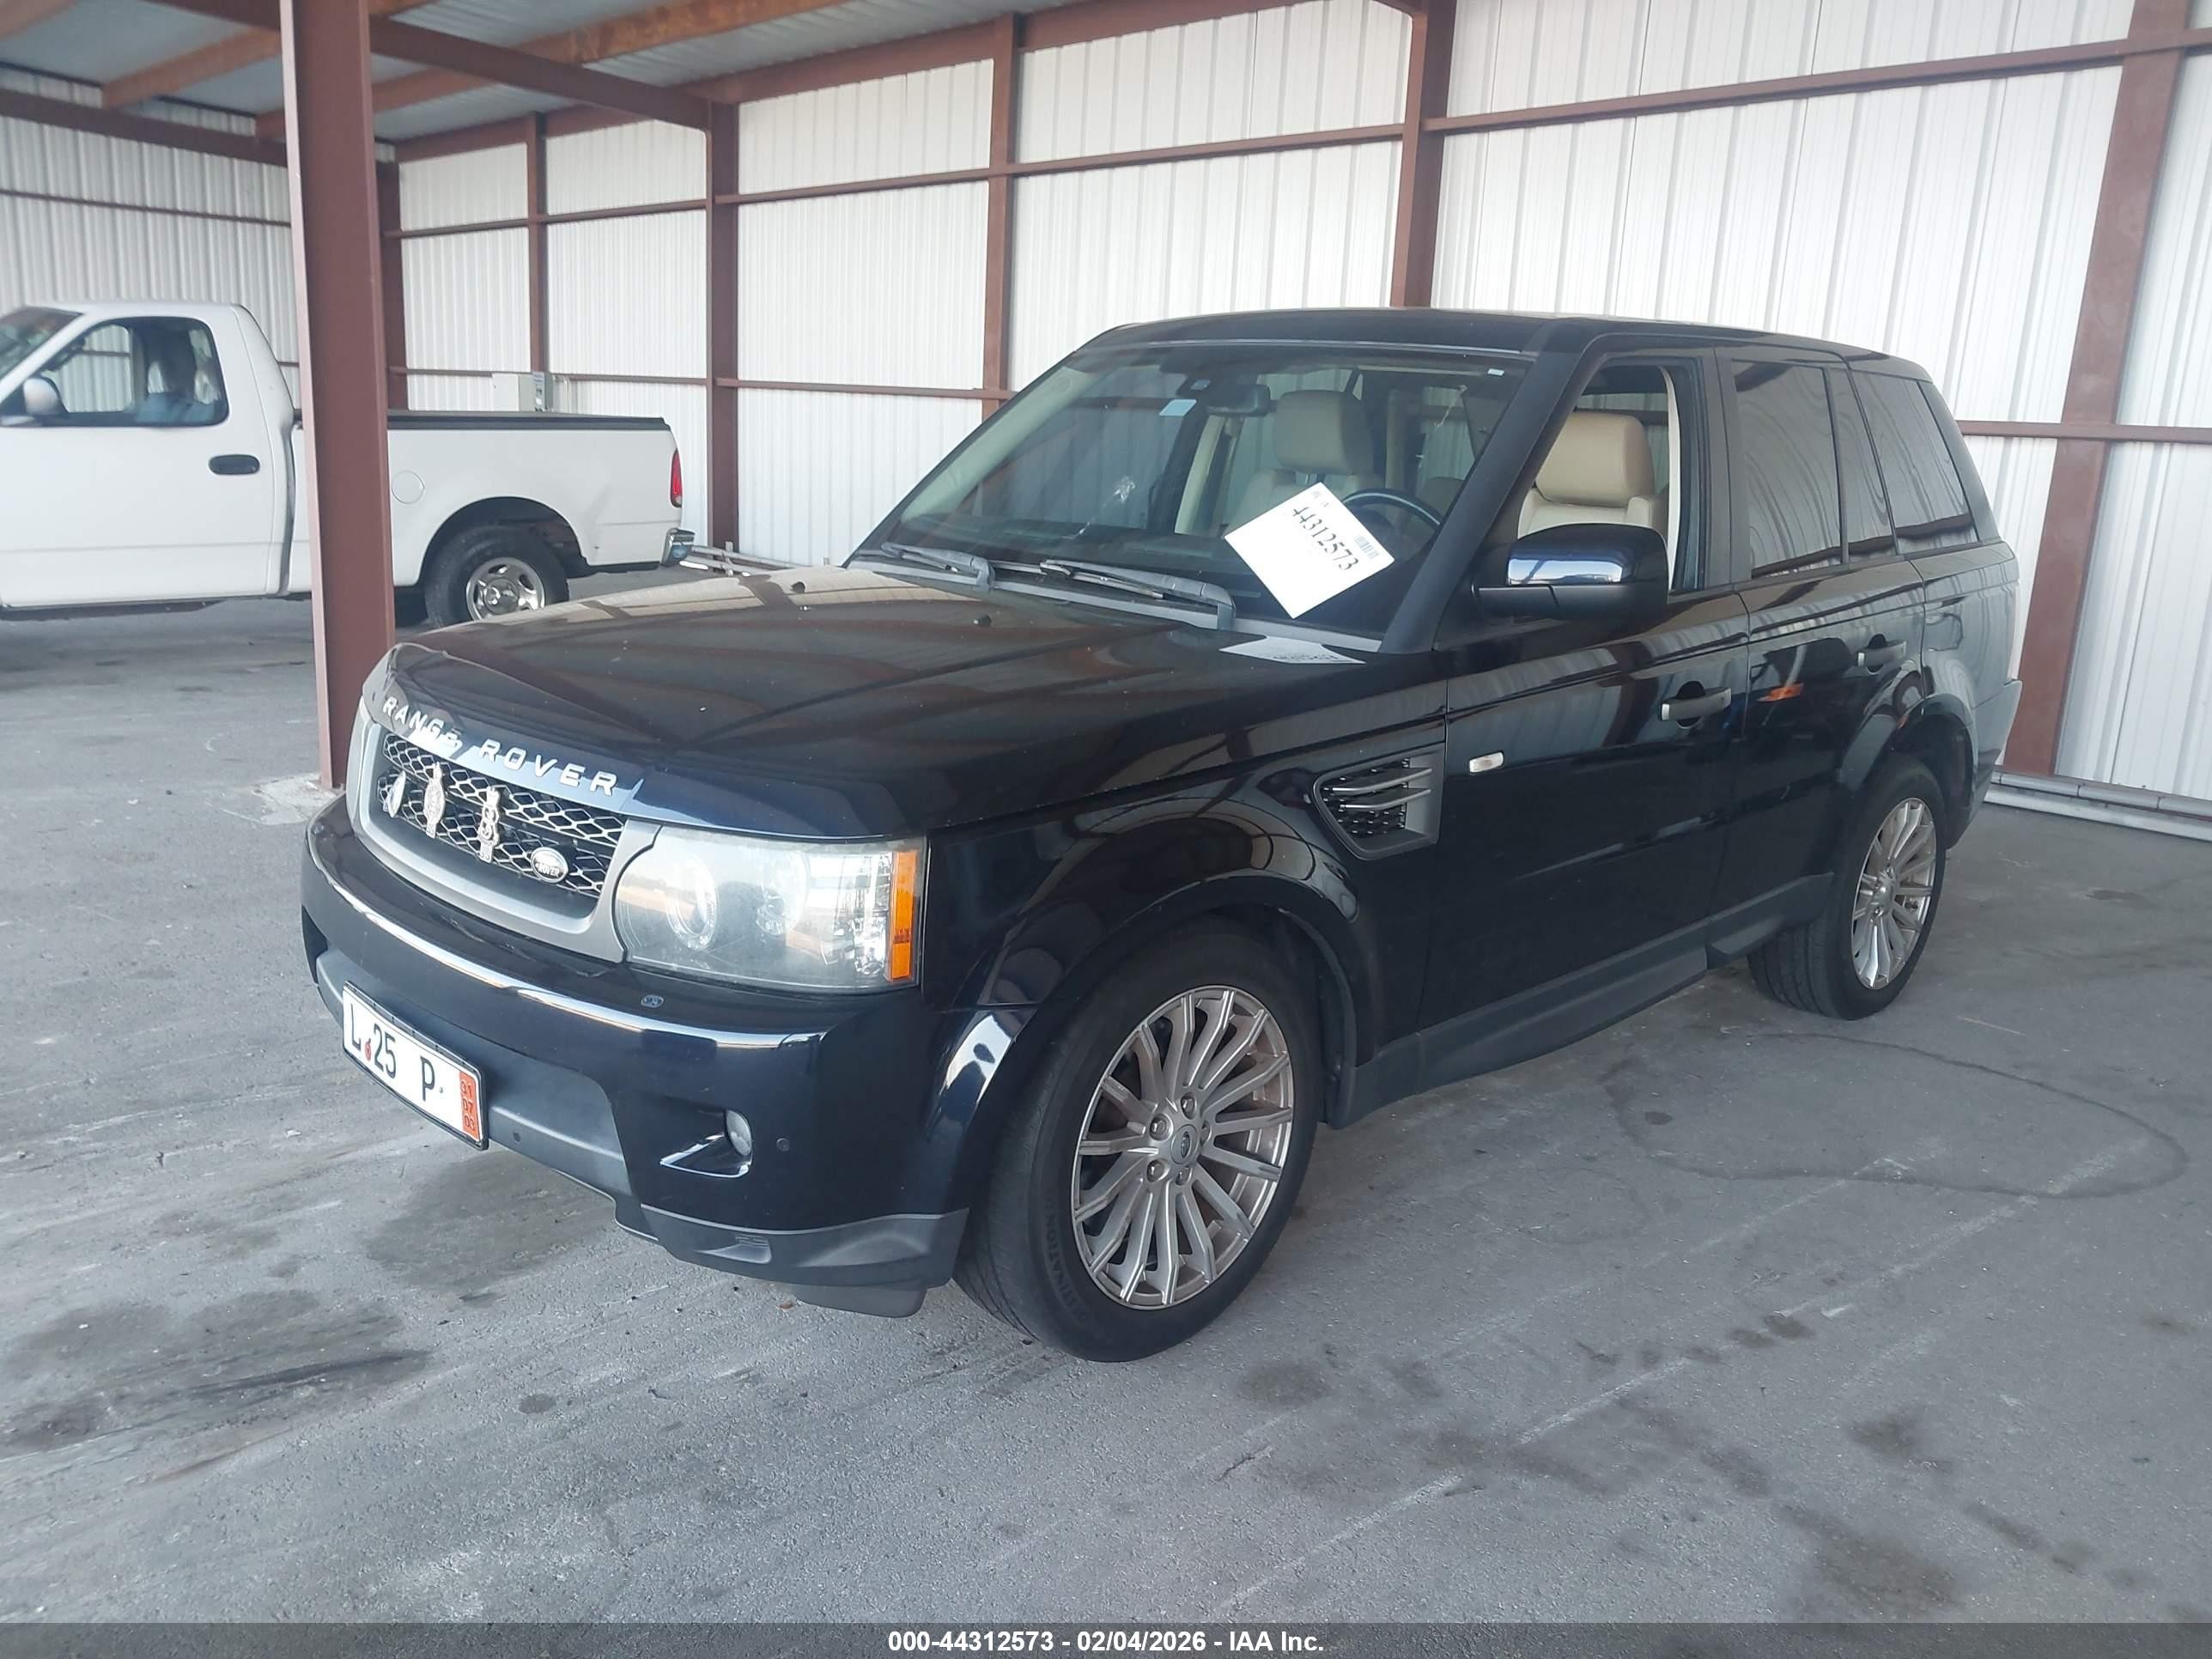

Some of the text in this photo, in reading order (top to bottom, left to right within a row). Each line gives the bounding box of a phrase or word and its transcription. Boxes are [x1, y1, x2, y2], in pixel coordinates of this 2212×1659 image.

[1291, 506, 1359, 571] 44312573
[382, 696, 618, 797] RANGE ROVER
[538, 862, 560, 878] ROVER
[350, 1002, 435, 1103] L 25 P
